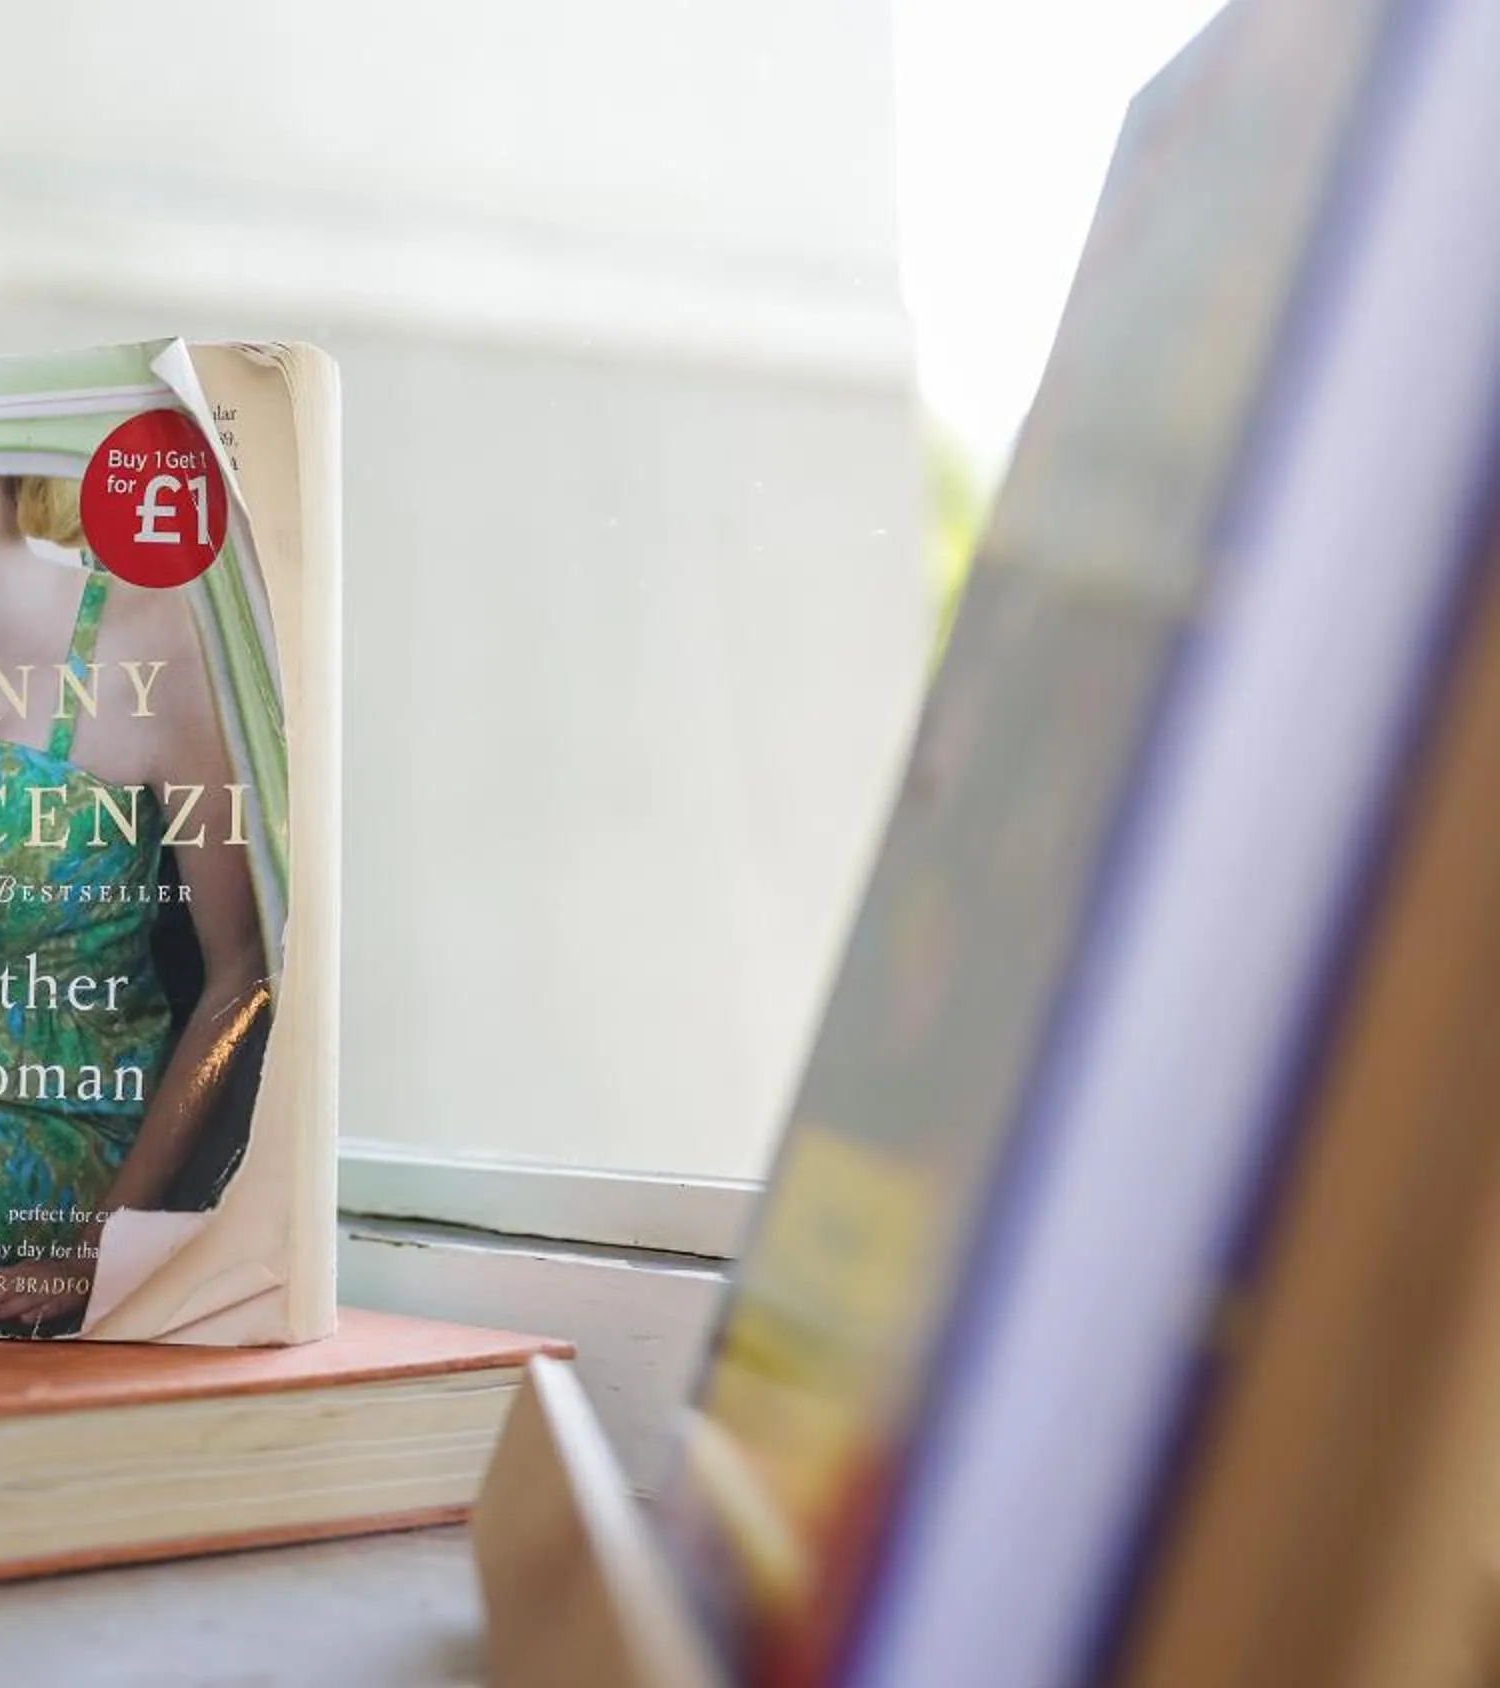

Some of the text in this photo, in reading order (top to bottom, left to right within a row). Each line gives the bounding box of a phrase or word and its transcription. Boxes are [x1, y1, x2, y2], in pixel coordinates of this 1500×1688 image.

[108, 450, 147, 472] Buy
[154, 451, 161, 468] 1
[166, 451, 196, 469] Get
[107, 474, 210, 545] for £1
[8, 1202, 64, 1224] perfect
[69, 1204, 93, 1223] for
[16, 1239, 45, 1260] day
[51, 1240, 73, 1258] for
[77, 1241, 100, 1260] tha
[15, 1275, 90, 1295] BRADFO
